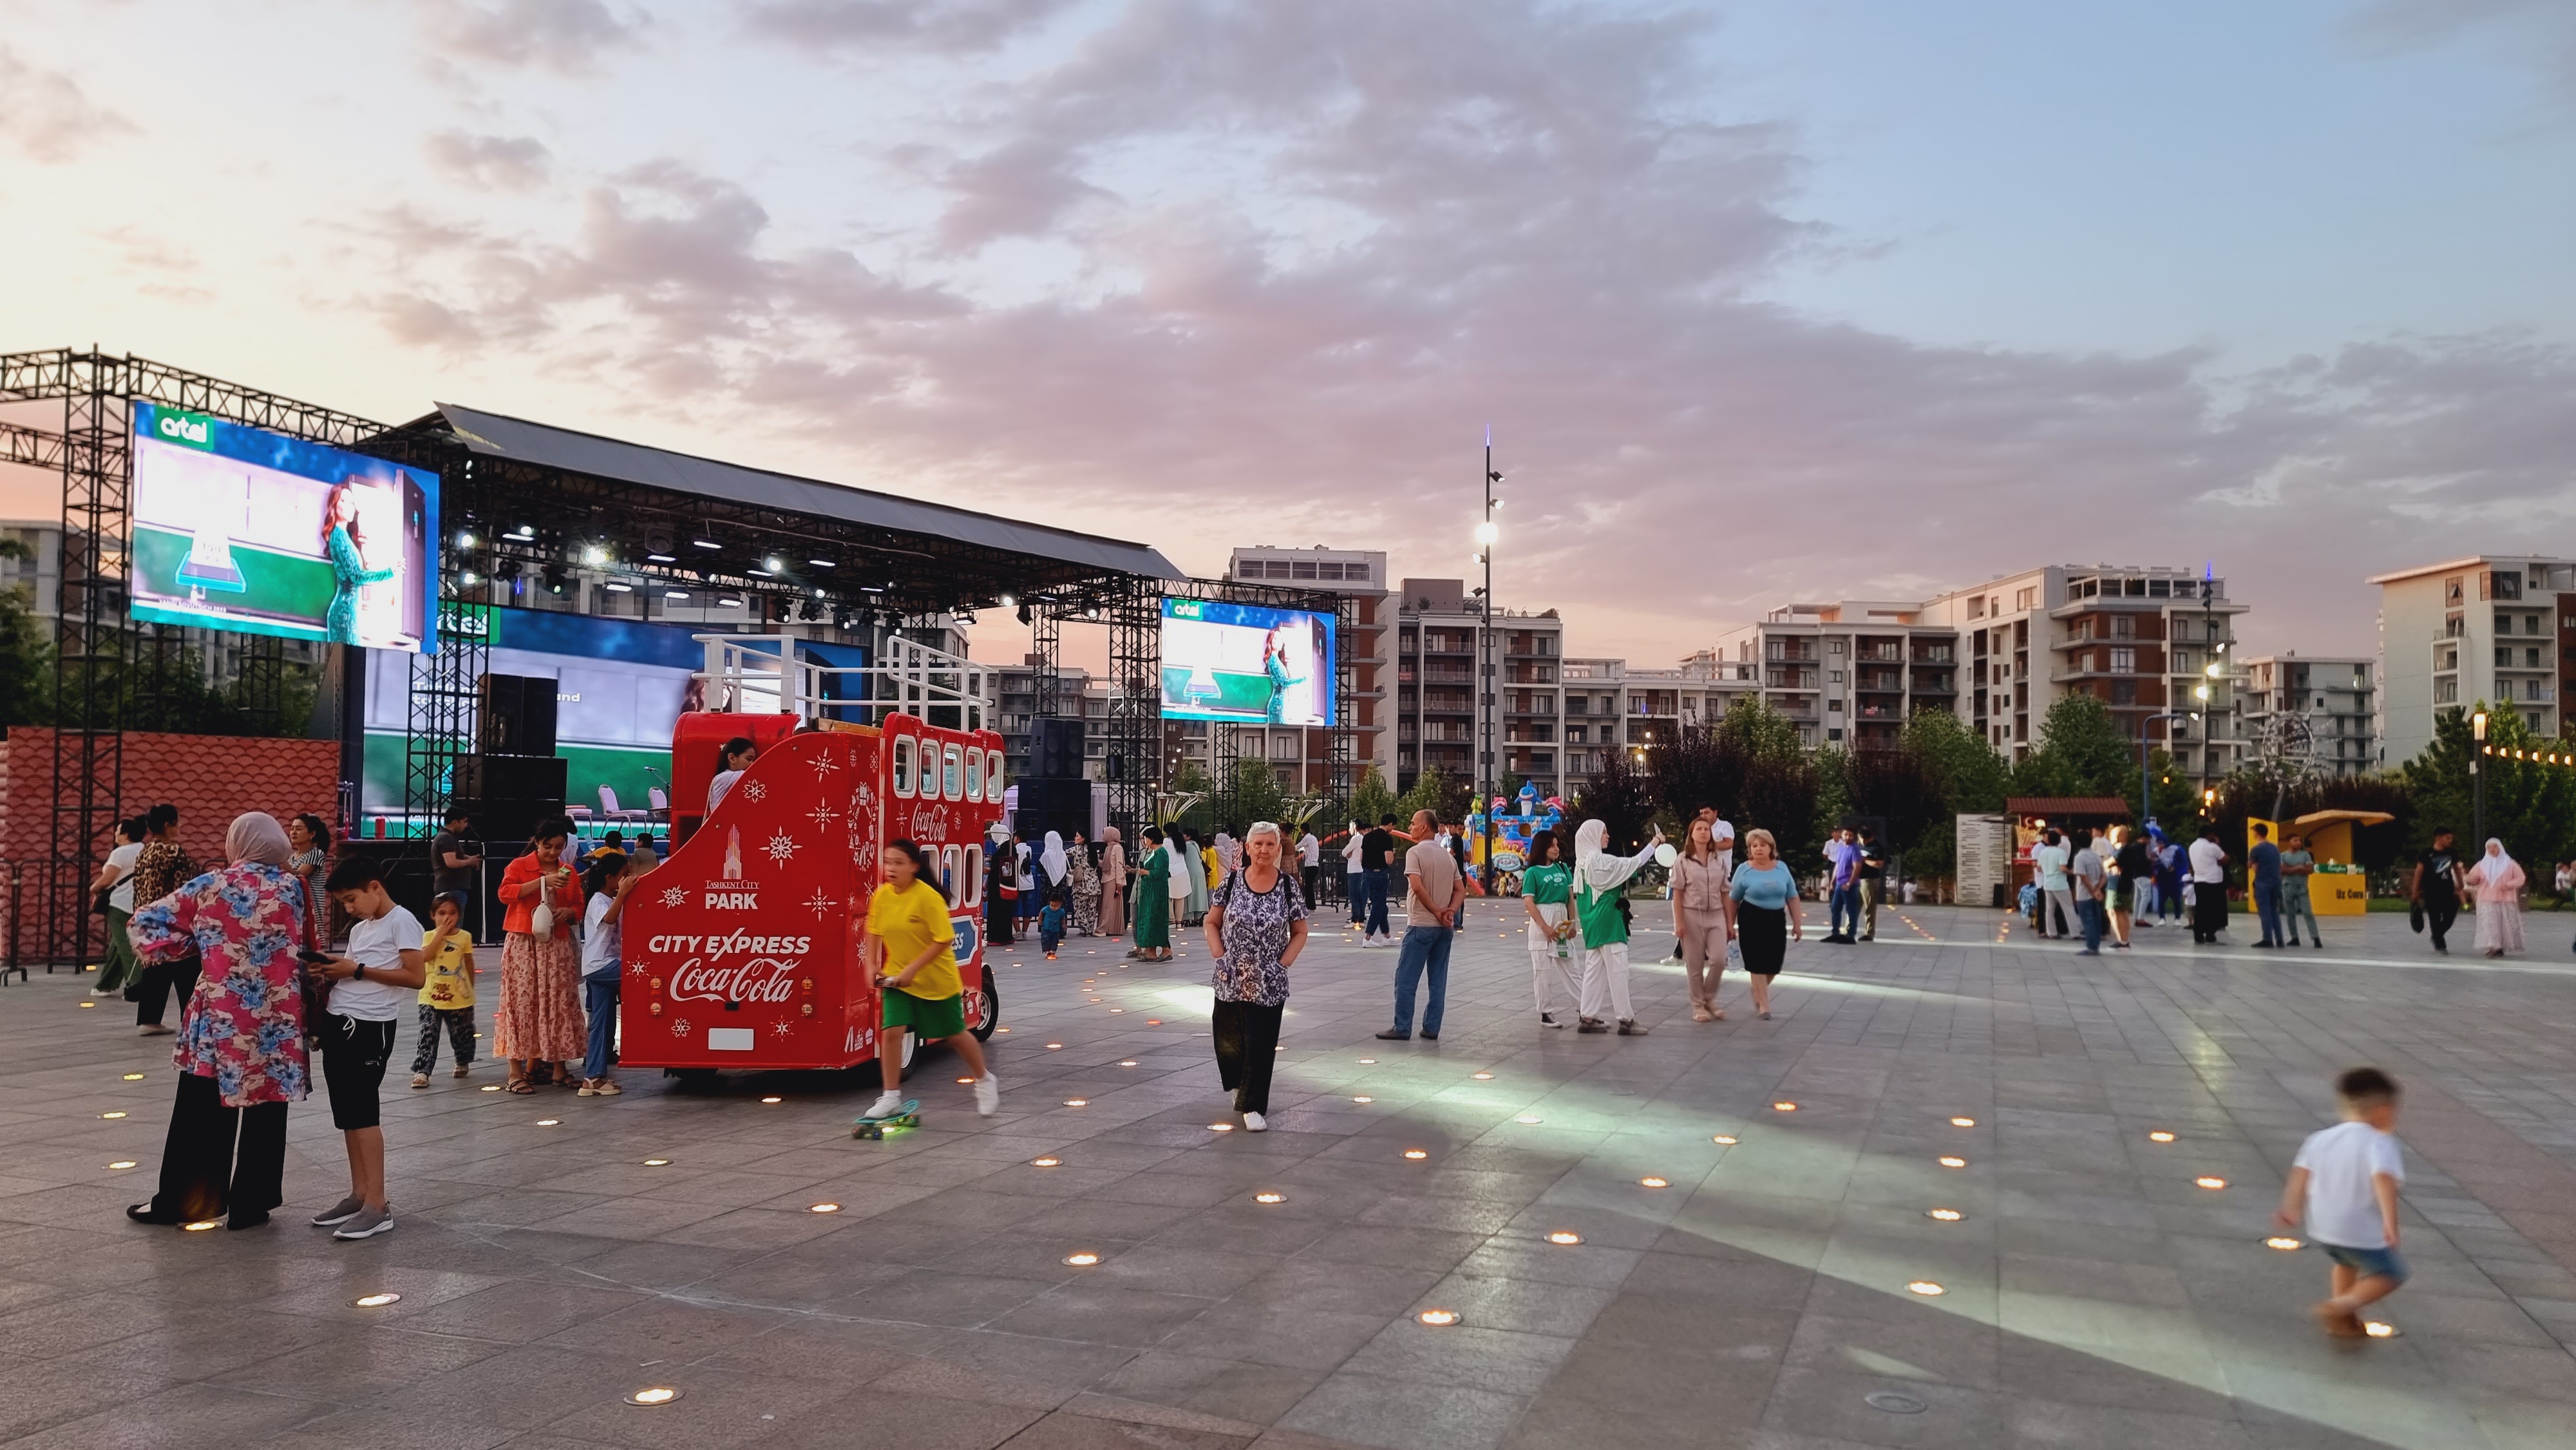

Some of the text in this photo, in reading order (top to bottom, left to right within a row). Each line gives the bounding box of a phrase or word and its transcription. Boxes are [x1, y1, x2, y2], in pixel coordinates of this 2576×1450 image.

[160, 417, 207, 443] artel
[911, 802, 949, 842] Coca-Cola
[705, 893, 758, 909] PARK
[649, 927, 811, 962] CITY EXPRESS
[670, 957, 802, 1003] Coca-Cola
